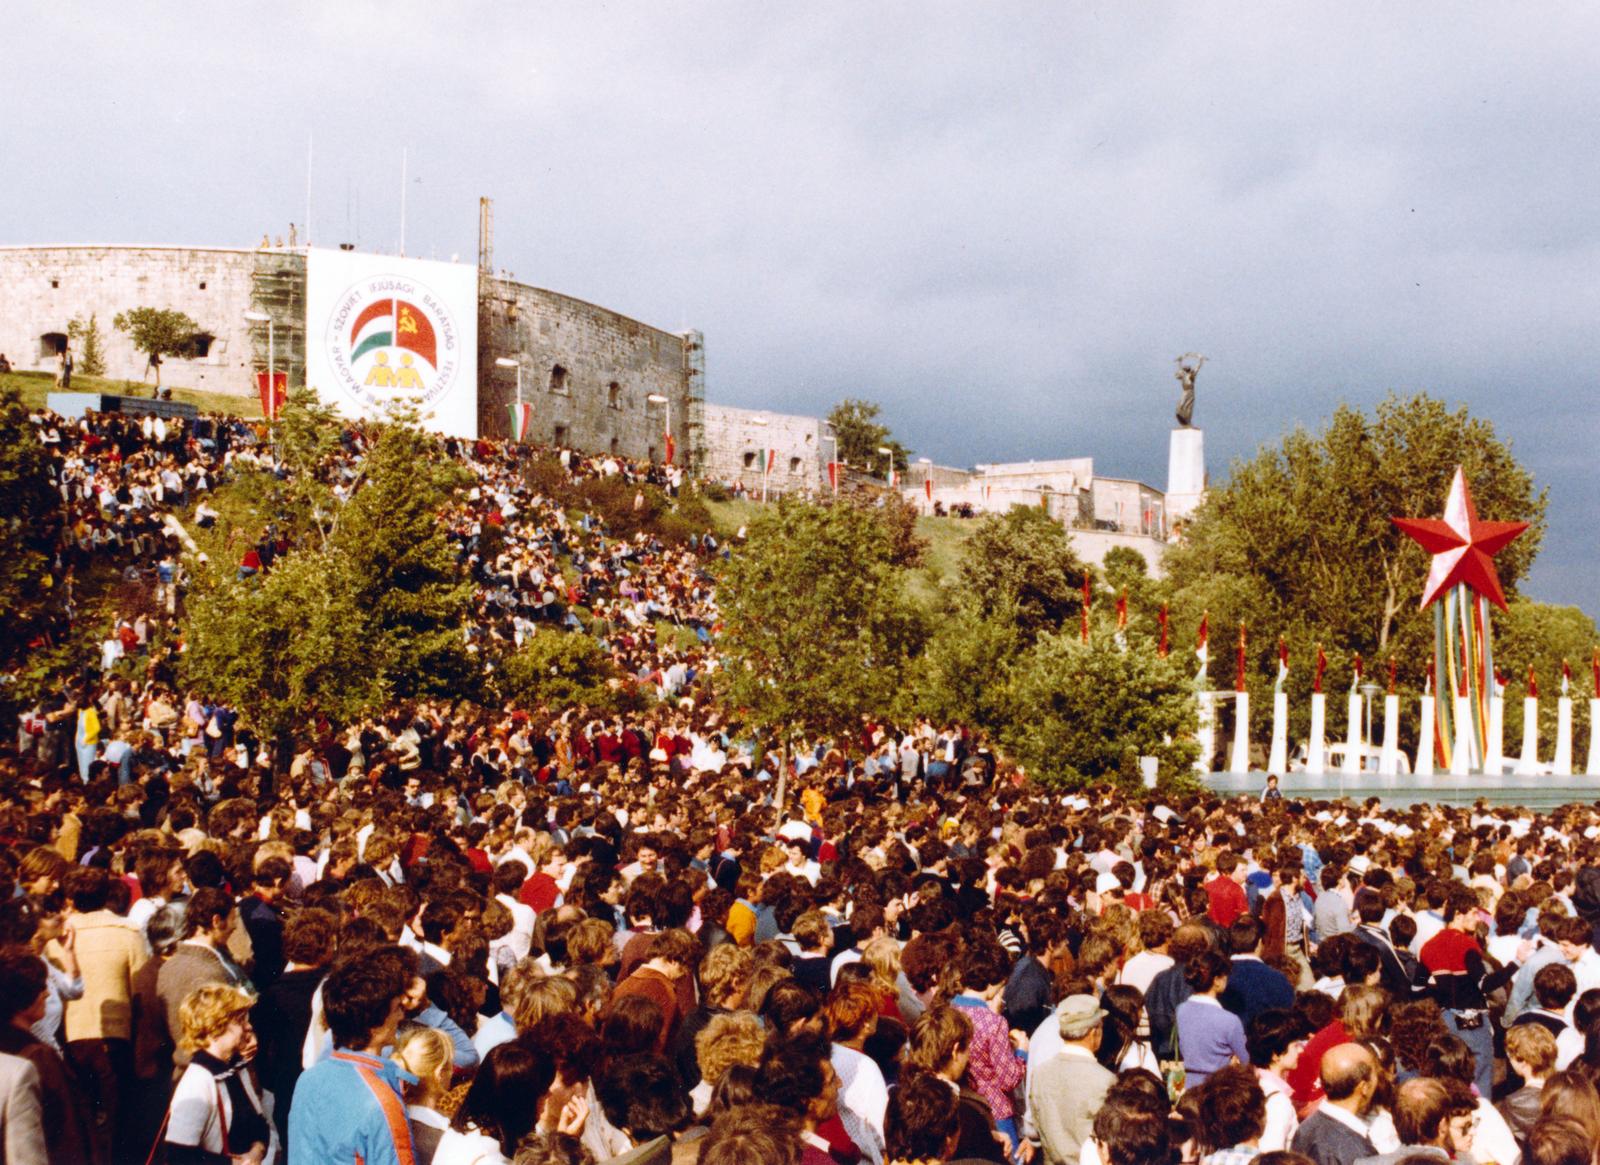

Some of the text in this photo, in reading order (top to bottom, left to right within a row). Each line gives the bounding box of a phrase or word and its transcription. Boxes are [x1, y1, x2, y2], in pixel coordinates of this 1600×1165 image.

[334, 290, 363, 331] SZOVJET
[333, 346, 362, 394] MAGYAR
[421, 360, 454, 401] FESZTIVÁ
